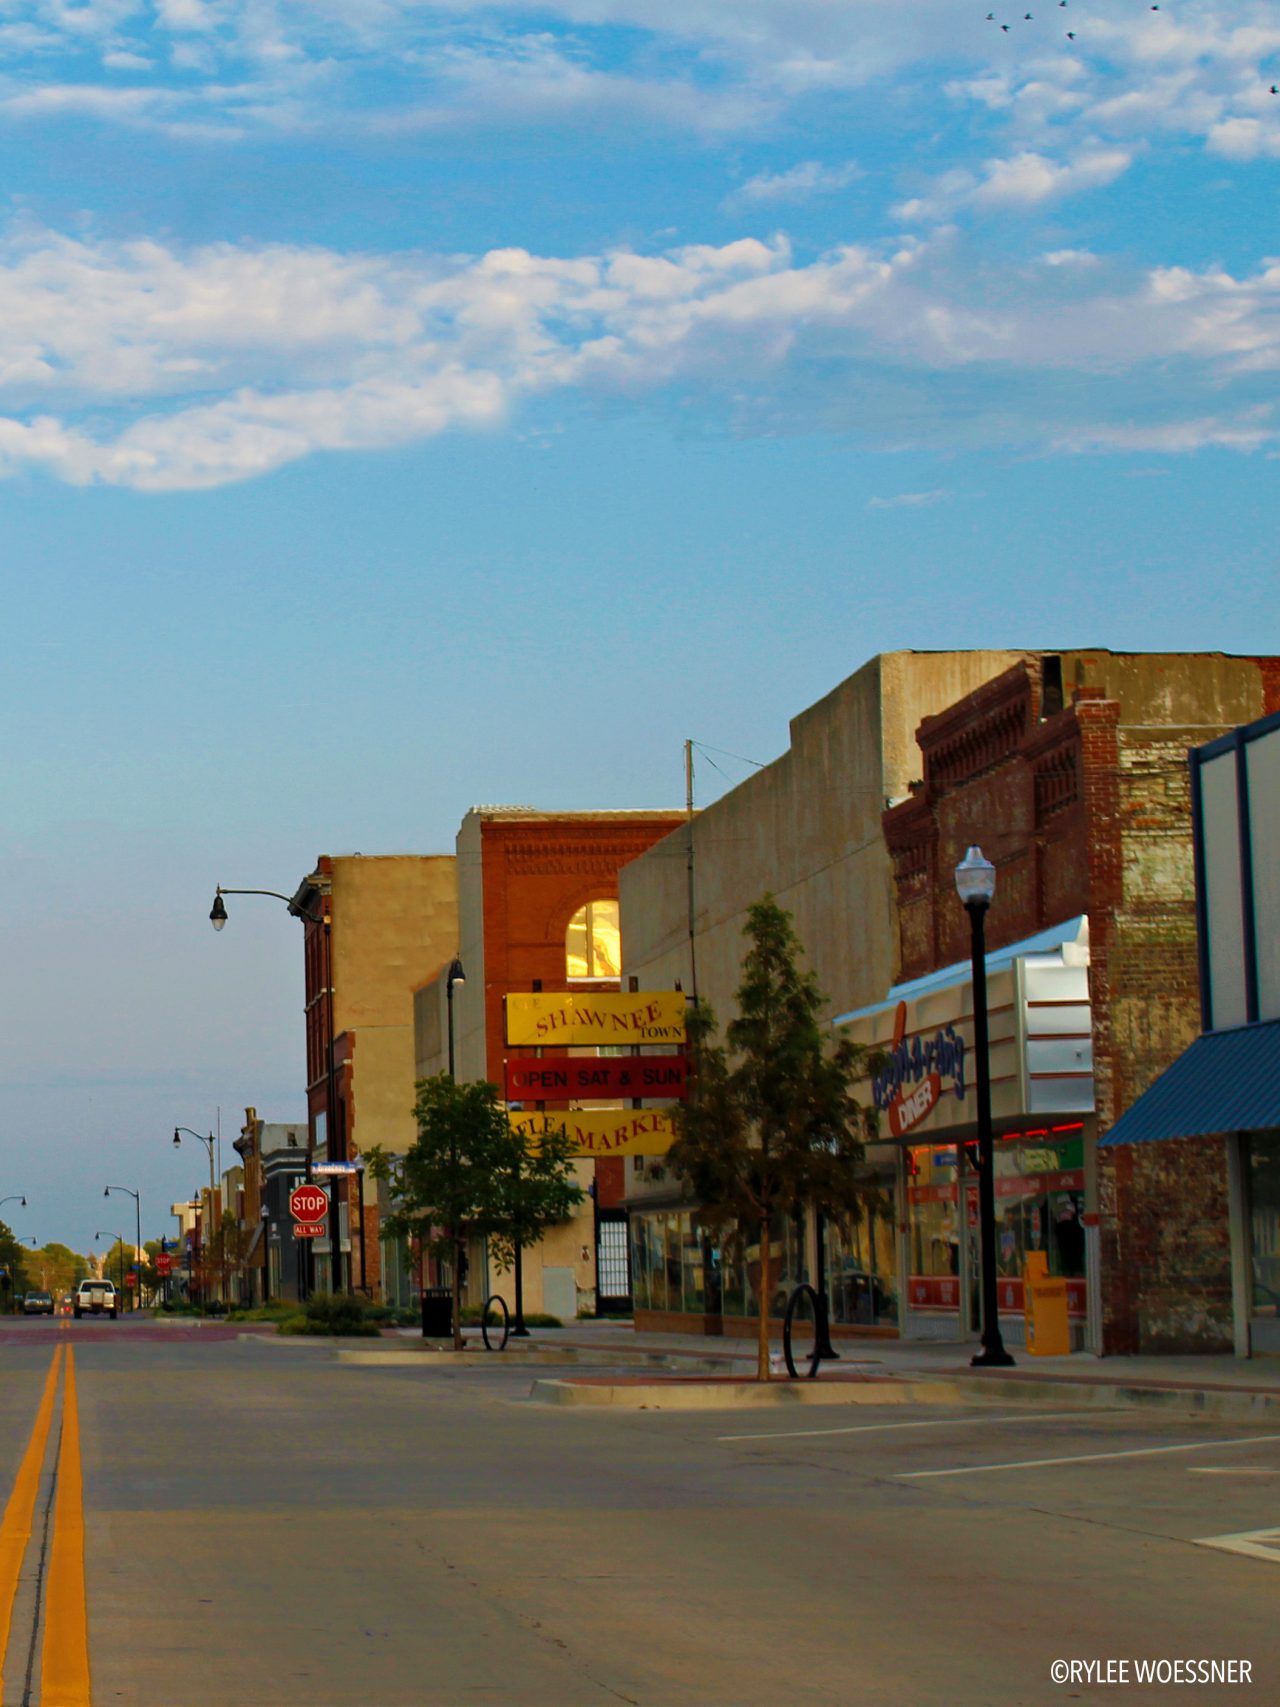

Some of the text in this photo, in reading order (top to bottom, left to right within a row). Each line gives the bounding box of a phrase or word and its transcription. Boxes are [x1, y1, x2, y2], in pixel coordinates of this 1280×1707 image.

[535, 1000, 662, 1039] SHAWNEE
[640, 1026, 683, 1039] TOWN
[512, 1067, 682, 1089] OPEN SAT & SUN
[897, 1080, 933, 1131] DINER
[516, 1117, 568, 1139] FLEA
[293, 1196, 325, 1211] STOP
